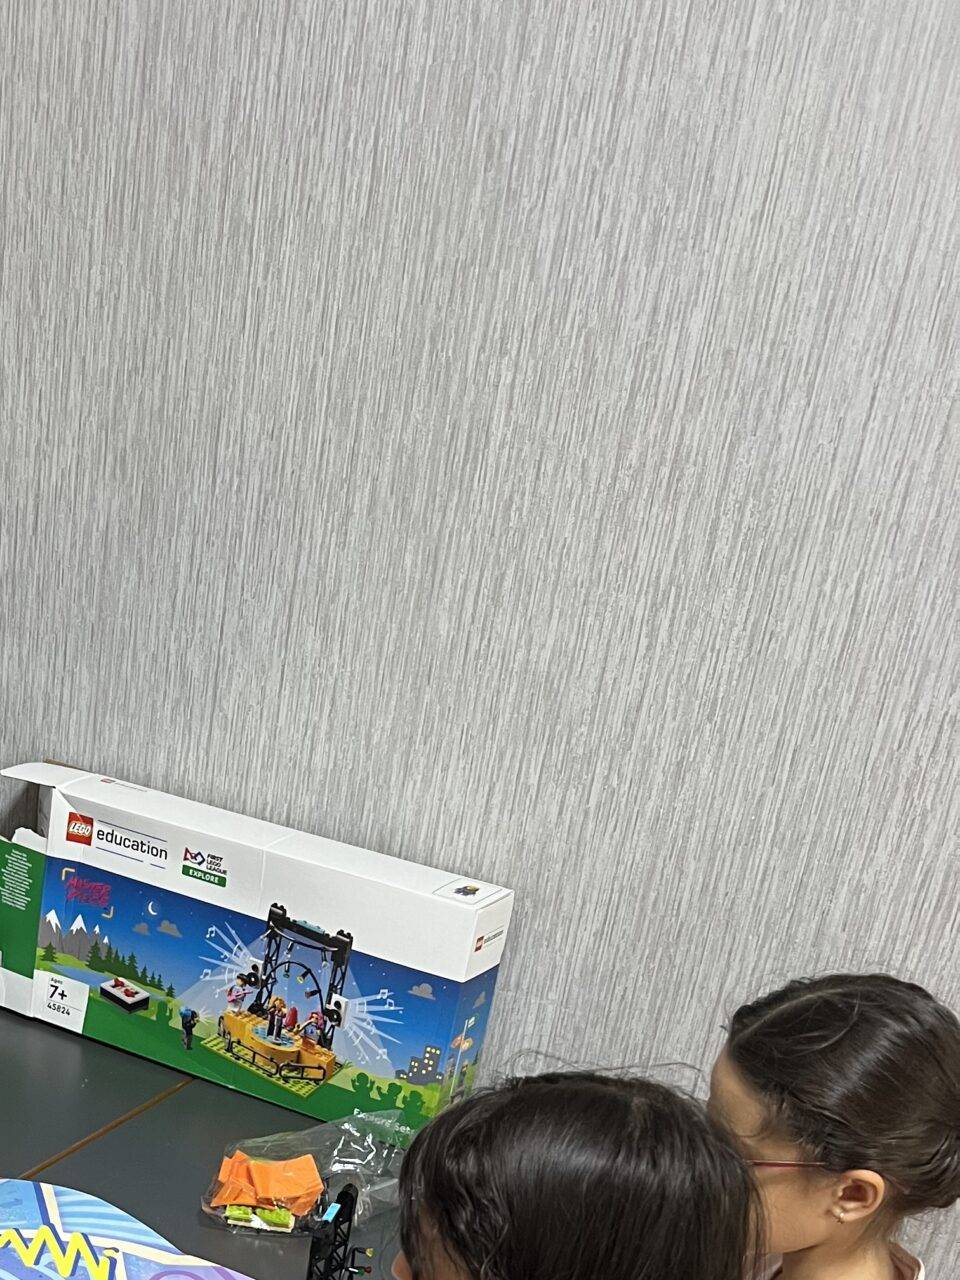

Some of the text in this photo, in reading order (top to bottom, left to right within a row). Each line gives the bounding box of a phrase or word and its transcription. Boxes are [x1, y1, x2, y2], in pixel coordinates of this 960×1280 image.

[68, 821, 168, 861] LEGO education
[206, 859, 221, 867] LEGO
[207, 853, 224, 862] FIRST
[189, 869, 219, 883] EXPLORE
[49, 984, 67, 1000] 7+
[47, 1002, 71, 1016] 45824
